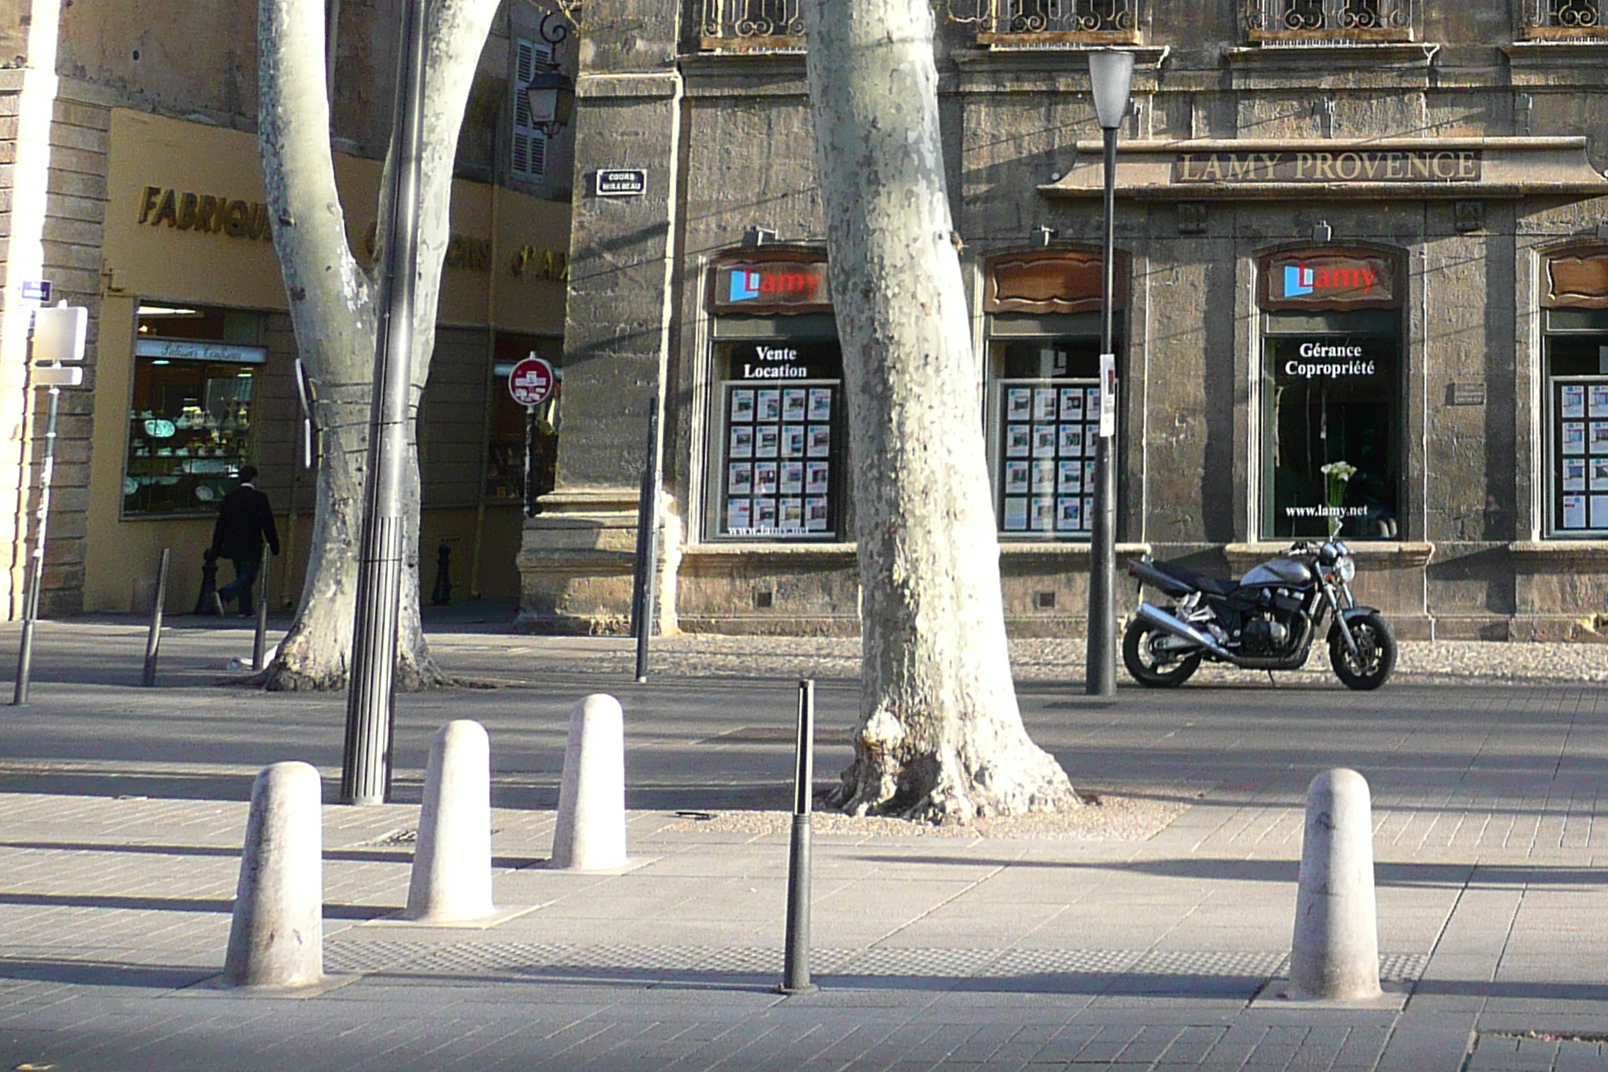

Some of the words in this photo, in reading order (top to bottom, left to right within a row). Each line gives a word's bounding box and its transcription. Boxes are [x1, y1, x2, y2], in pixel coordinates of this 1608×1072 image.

[1181, 153, 1282, 180] LAMY
[1295, 151, 1476, 179] PROVENCE
[138, 186, 273, 241] FABRIQU
[745, 267, 823, 300] Lamy
[1299, 263, 1378, 295] Lamy
[756, 346, 797, 361] Vente
[1299, 343, 1362, 358] Gérance
[743, 364, 807, 379] Location
[1285, 360, 1375, 379] Copropriété
[1286, 503, 1368, 519] www.lamy.net
